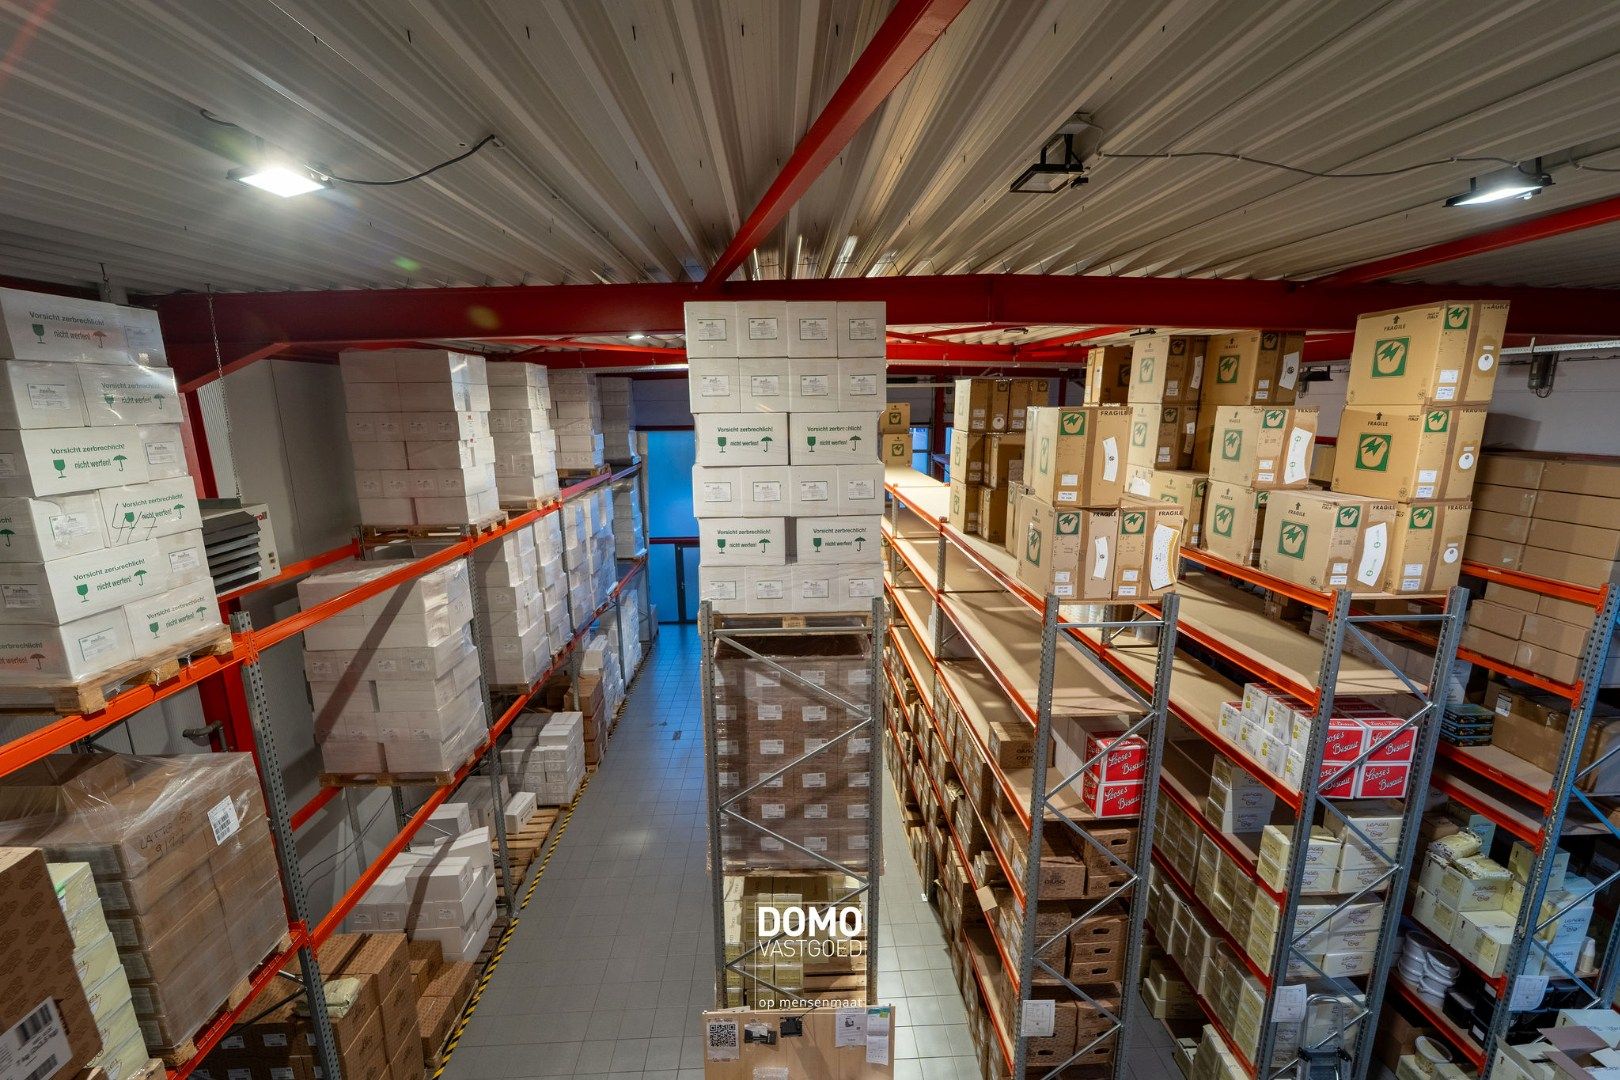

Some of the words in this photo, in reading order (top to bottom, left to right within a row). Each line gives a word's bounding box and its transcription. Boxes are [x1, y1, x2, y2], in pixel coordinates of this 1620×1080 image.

[50, 446, 81, 455] Vorsicht
[74, 460, 90, 469] nicht
[90, 458, 111, 468] werfen!
[122, 498, 147, 508] Vorsicht
[73, 568, 103, 581] Vorsicht
[96, 582, 112, 591] nicht
[112, 575, 132, 588] werfen!
[146, 607, 171, 620] Vorsicht
[165, 619, 177, 628] nicht
